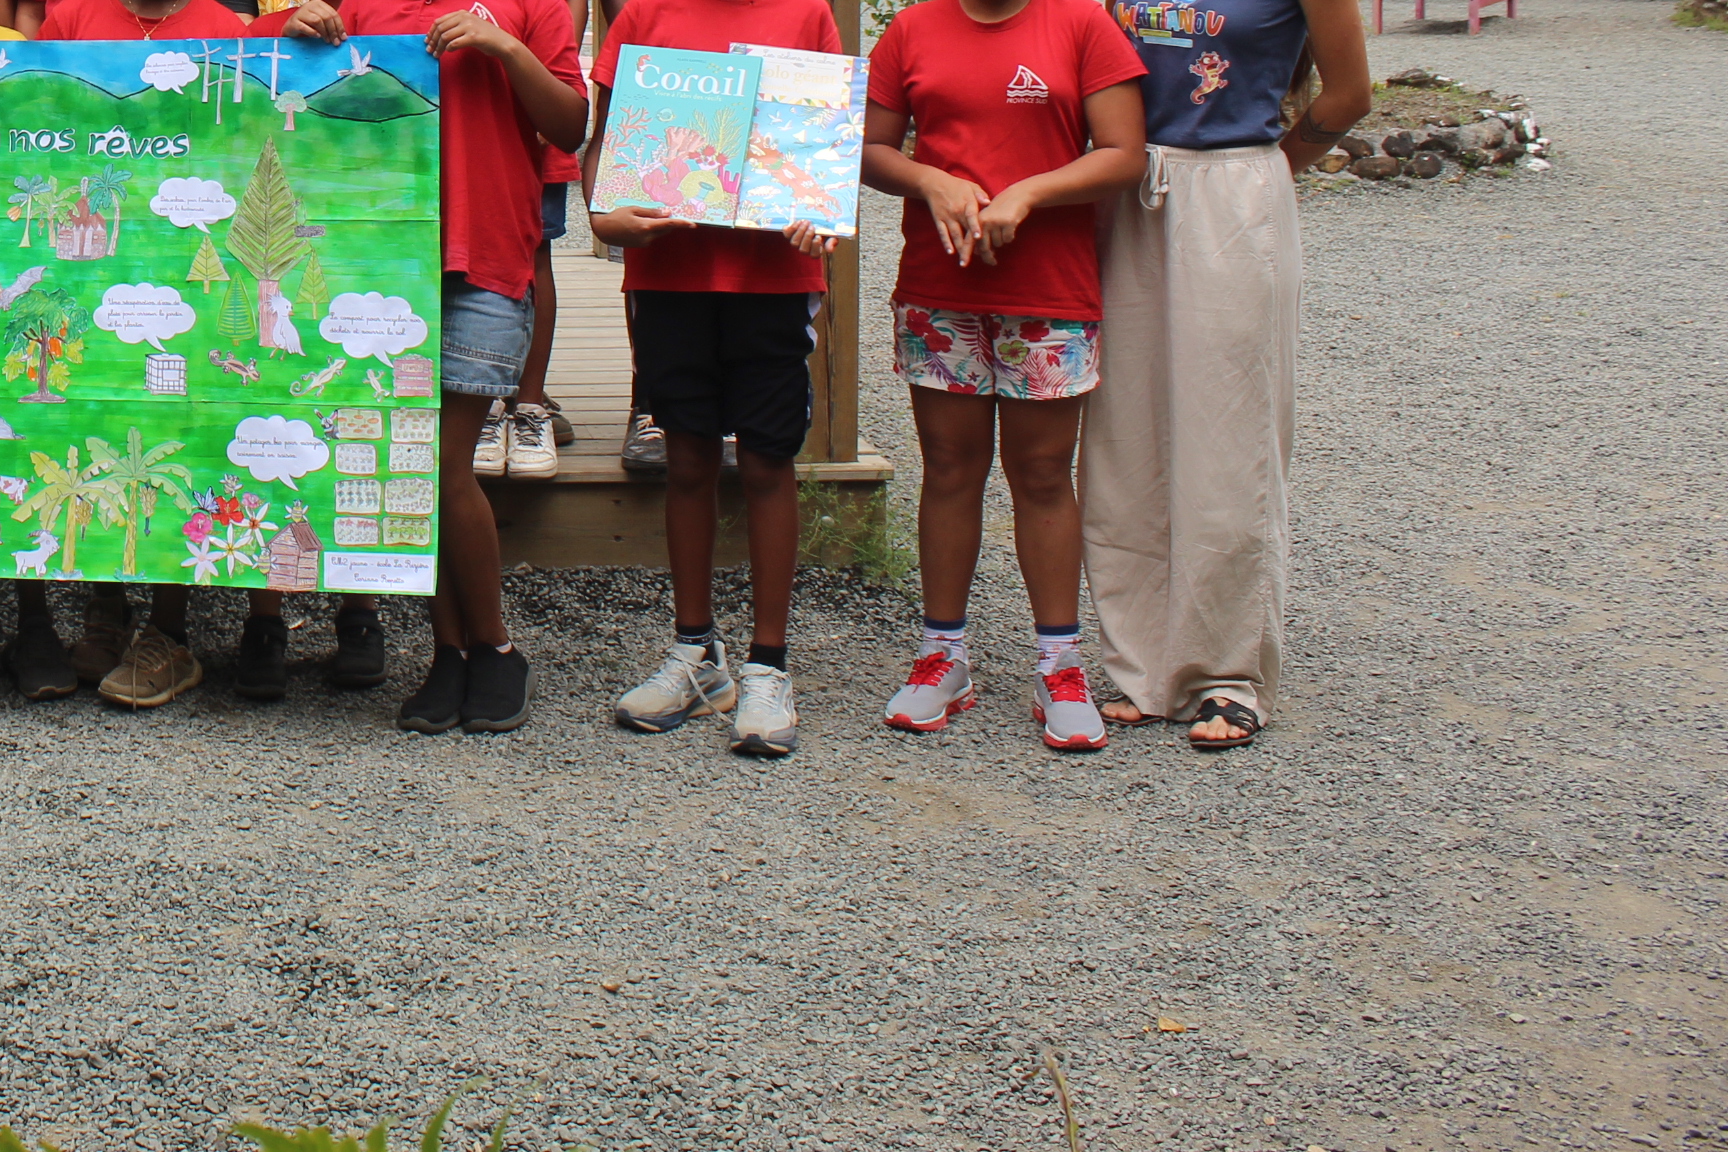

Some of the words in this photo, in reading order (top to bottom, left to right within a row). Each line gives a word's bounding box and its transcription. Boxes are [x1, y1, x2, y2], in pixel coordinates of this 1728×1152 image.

[1117, 2, 1225, 38] WATTANOU
[634, 64, 747, 97] Corail
[9, 128, 76, 152] nos
[88, 125, 189, 159] rêves
